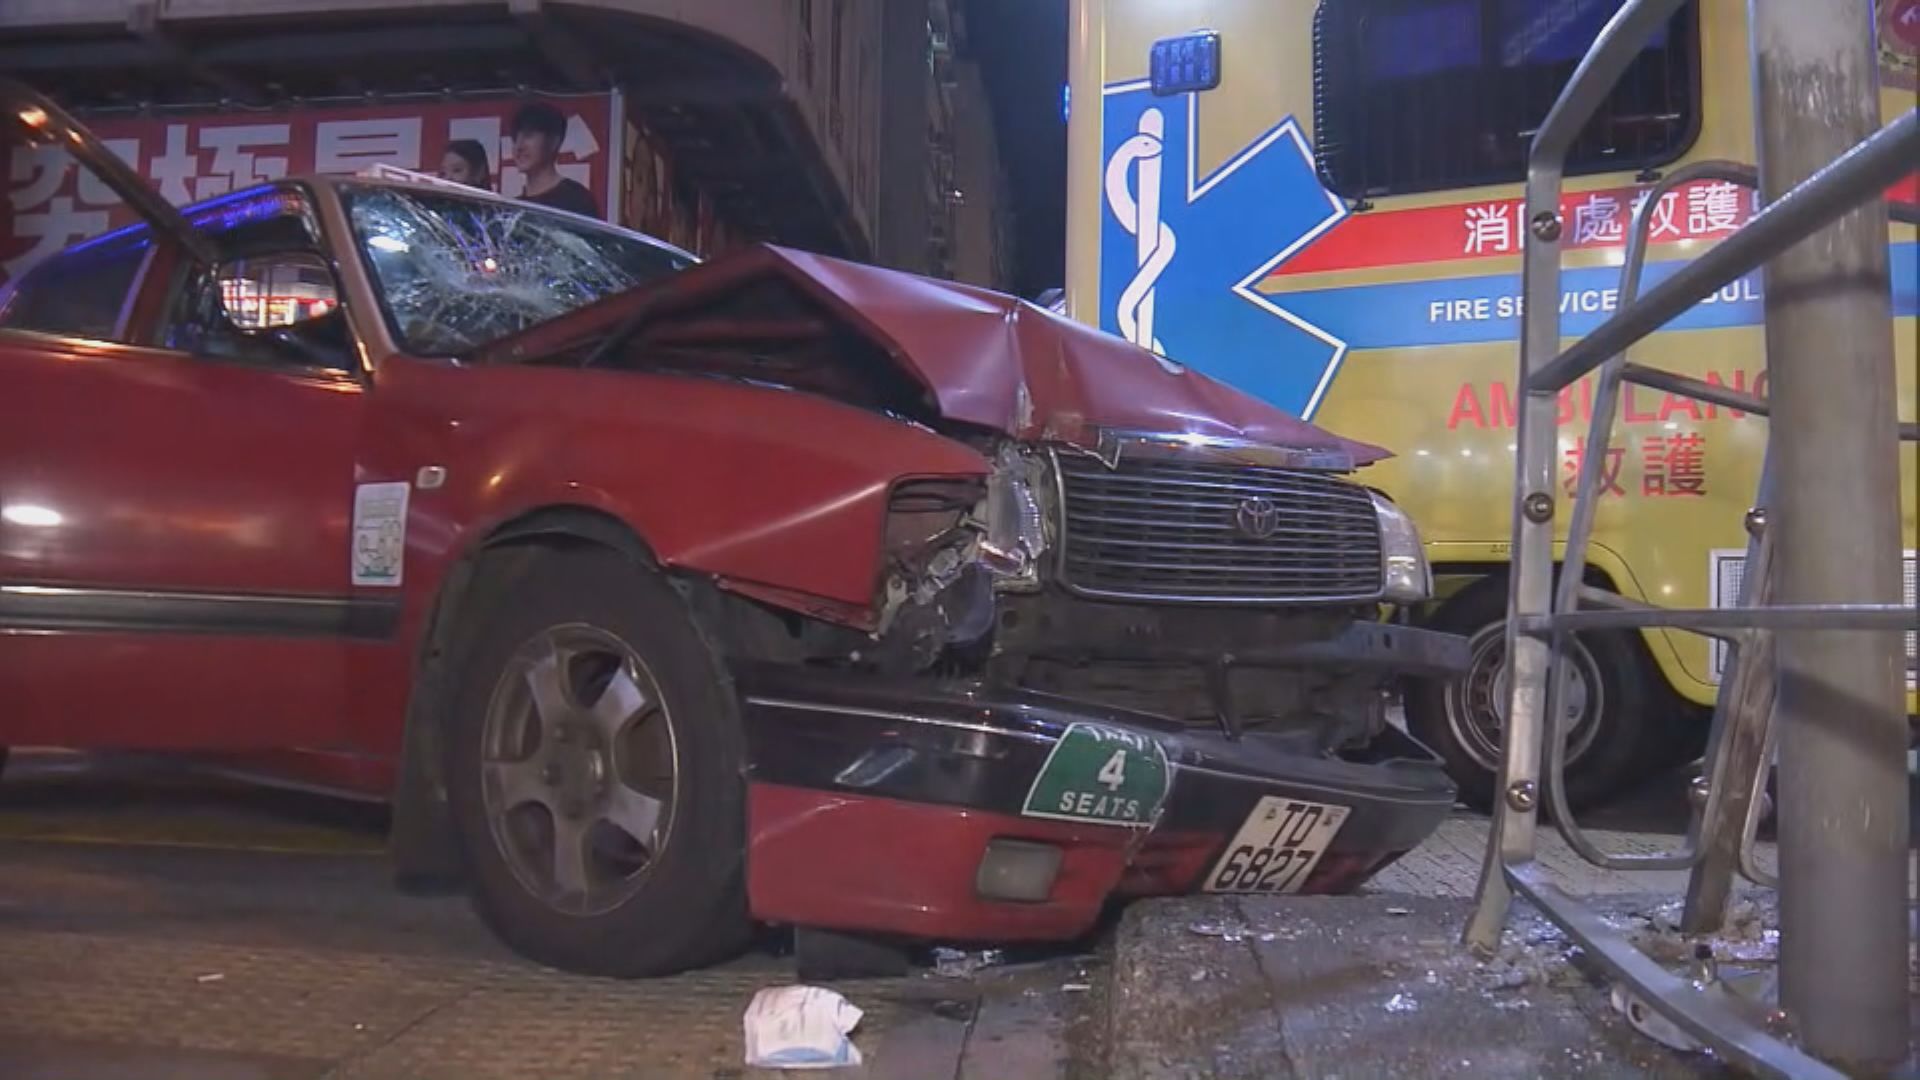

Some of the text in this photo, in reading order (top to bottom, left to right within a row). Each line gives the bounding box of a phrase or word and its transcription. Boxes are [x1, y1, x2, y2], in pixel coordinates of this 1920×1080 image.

[1464, 182, 1761, 253] 消處救護
[1429, 289, 1619, 324] FIRE SVICE
[1447, 368, 1770, 431] AMBLAN
[1564, 432, 1707, 499] 救護
[1098, 749, 1127, 791] 4
[1059, 790, 1139, 818] SEATS
[1214, 845, 1316, 891] 6827
